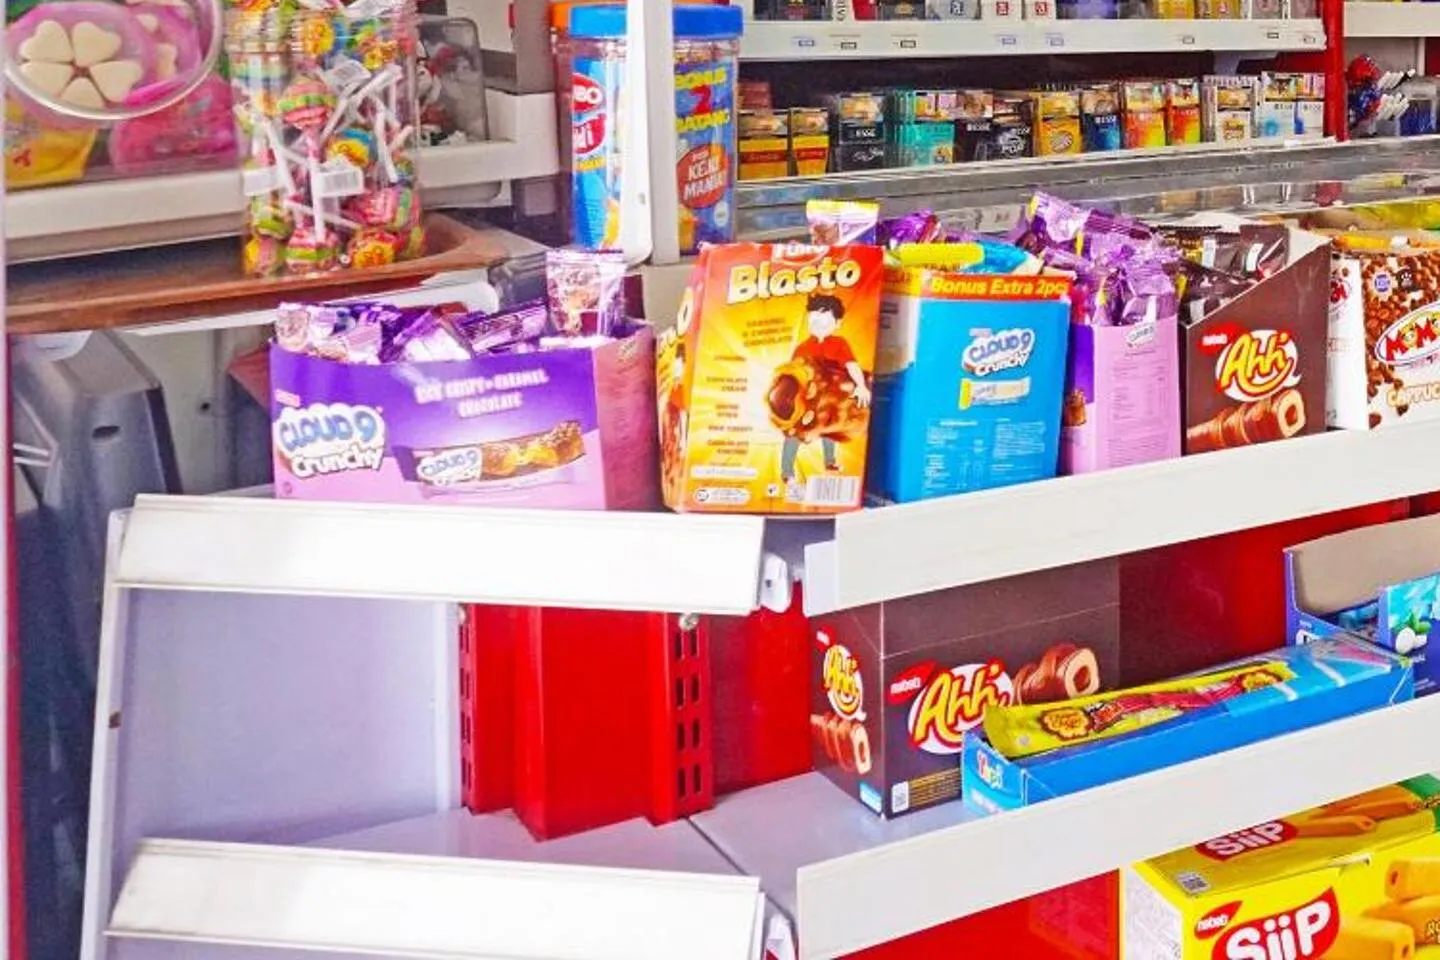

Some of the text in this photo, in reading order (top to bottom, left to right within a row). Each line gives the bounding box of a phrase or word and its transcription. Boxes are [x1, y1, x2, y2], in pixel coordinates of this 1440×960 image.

[727, 255, 862, 306] Blasto
[930, 277, 987, 295] Bonus
[990, 278, 1034, 296] Extra
[968, 331, 1033, 363] CLOUD 9
[278, 408, 379, 452] CLOUD 9
